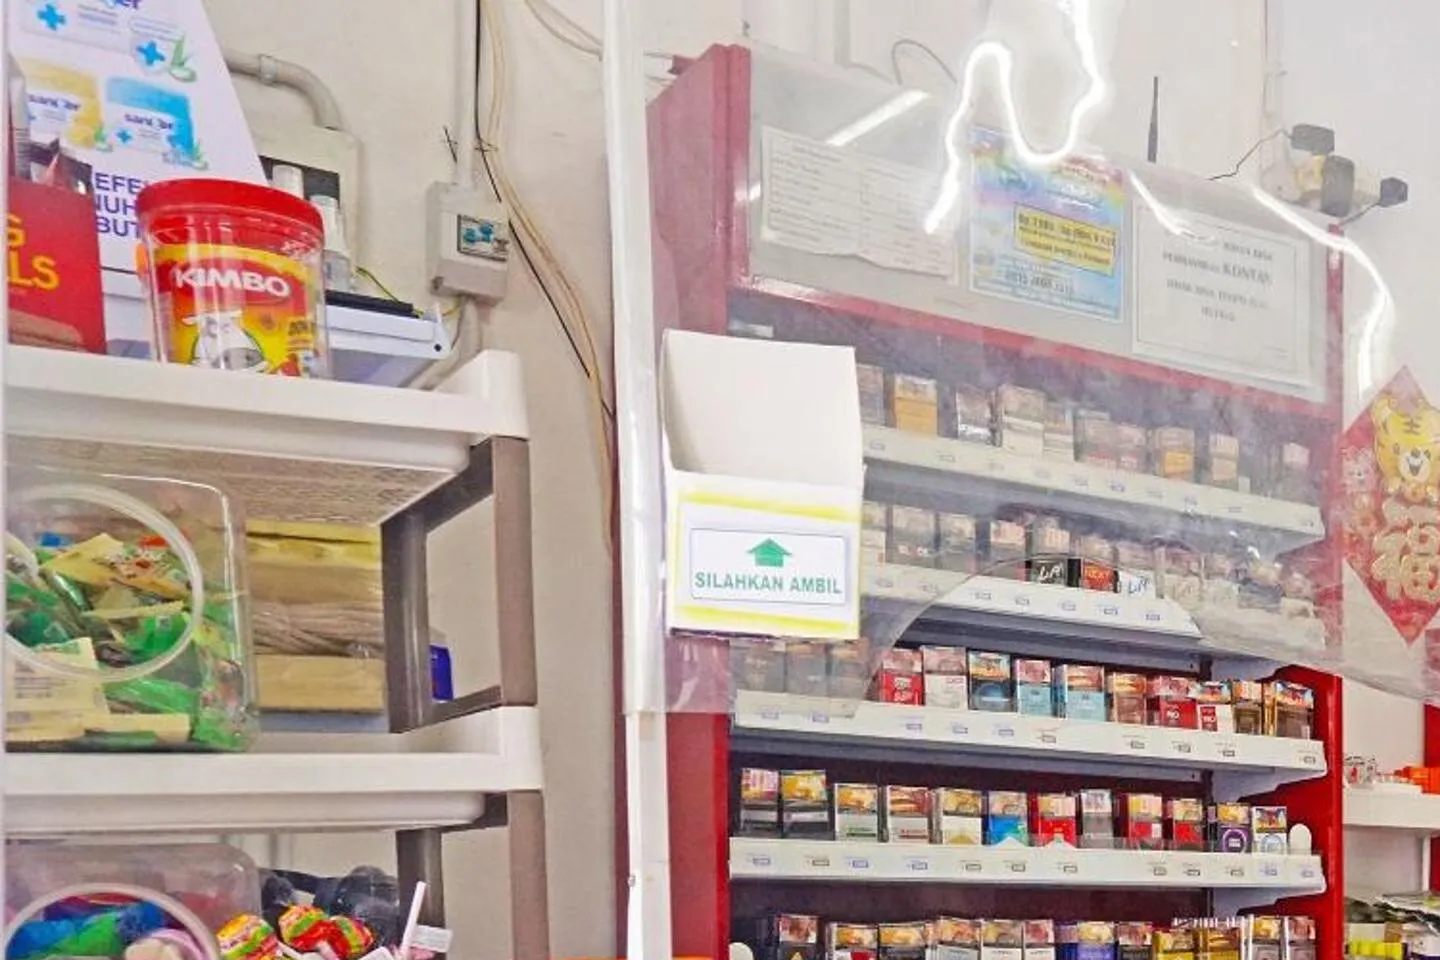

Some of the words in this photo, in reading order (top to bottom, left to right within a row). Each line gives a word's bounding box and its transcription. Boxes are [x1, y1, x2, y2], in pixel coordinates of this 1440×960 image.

[174, 267, 291, 298] KIMBO
[694, 571, 784, 592] SILAHKAN
[788, 576, 843, 594] AMBIL
